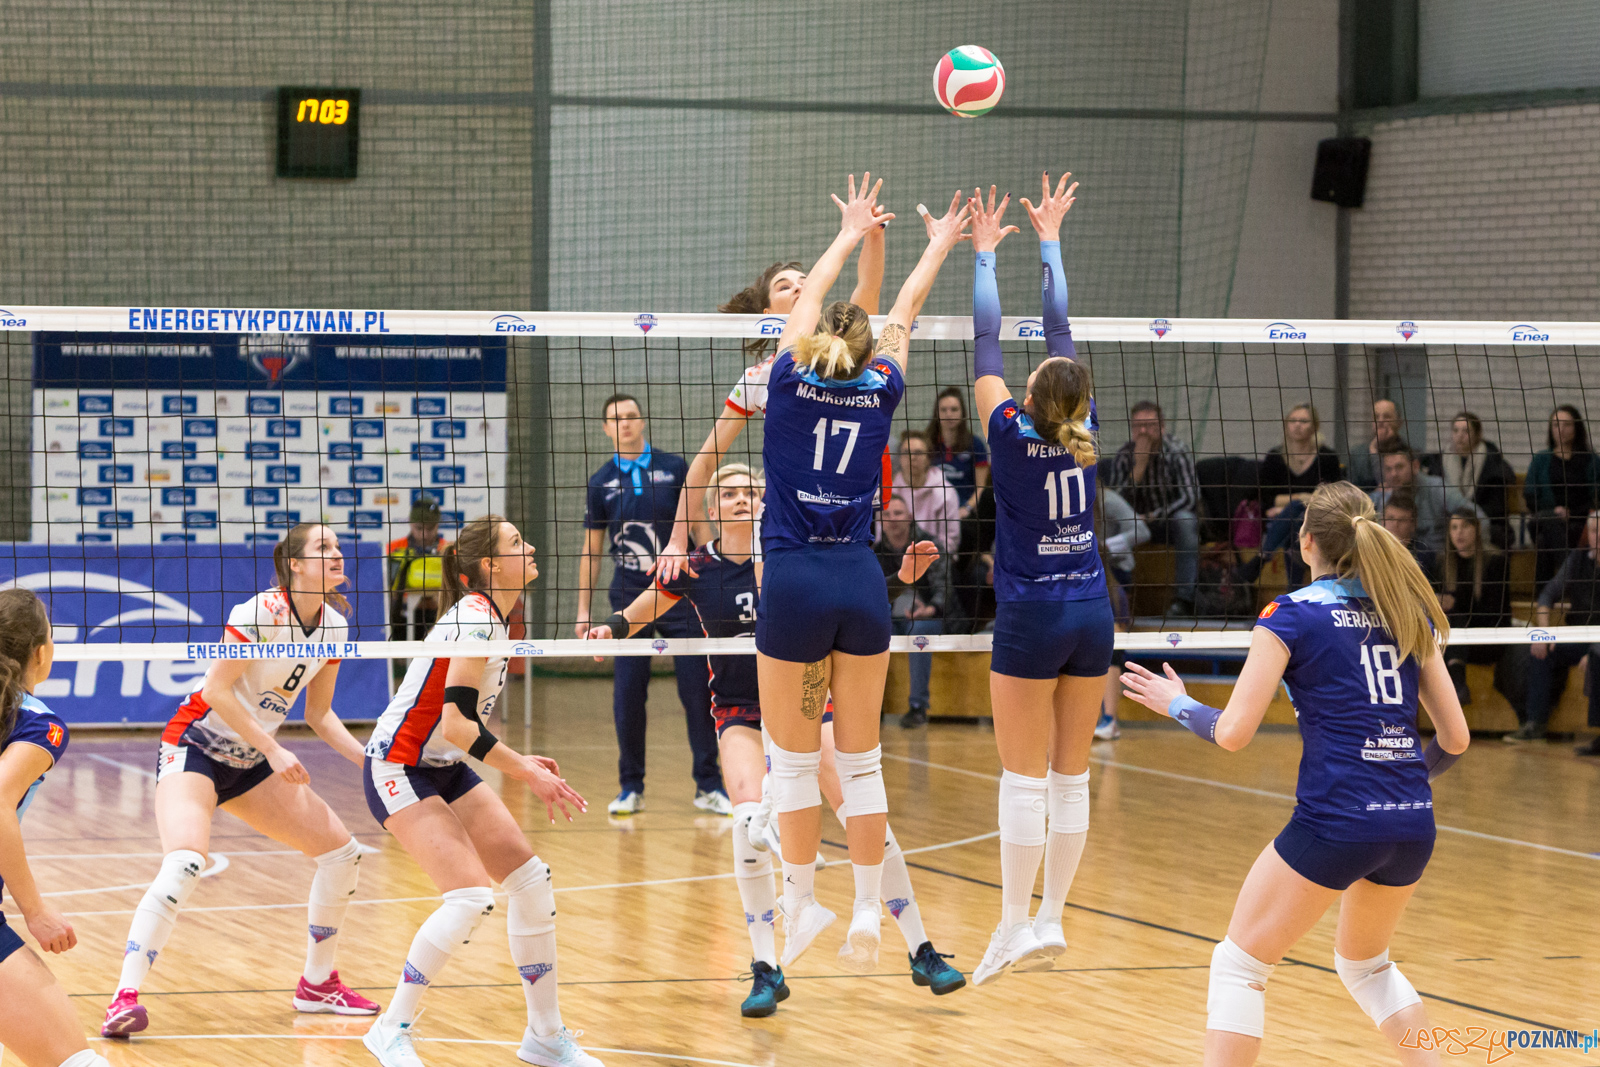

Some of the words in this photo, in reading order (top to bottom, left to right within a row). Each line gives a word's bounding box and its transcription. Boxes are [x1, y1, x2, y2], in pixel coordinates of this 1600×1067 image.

[0, 318, 27, 327] nea
[128, 308, 390, 333] ENERGETYKPOZNAN.PL
[495, 321, 537, 332] Enea
[761, 324, 784, 335] En
[1018, 326, 1045, 337] Ene
[1269, 330, 1307, 340] Enea
[1512, 332, 1549, 342] Enea
[796, 382, 881, 408] MAJKOWSKA
[812, 417, 861, 475] 17
[1044, 467, 1086, 520] 10
[1054, 521, 1082, 538] Joker
[735, 592, 757, 624] 3
[1330, 609, 1390, 628] SIERAD
[1530, 634, 1556, 642] Enea
[187, 643, 362, 659] ENERGETYKPOZNAN.PL
[515, 647, 544, 656] Enea
[283, 663, 307, 691] 8
[1360, 644, 1403, 705] 18
[1379, 719, 1406, 738] Joker
[1377, 737, 1415, 749] MEKRO
[385, 780, 399, 797] 2
